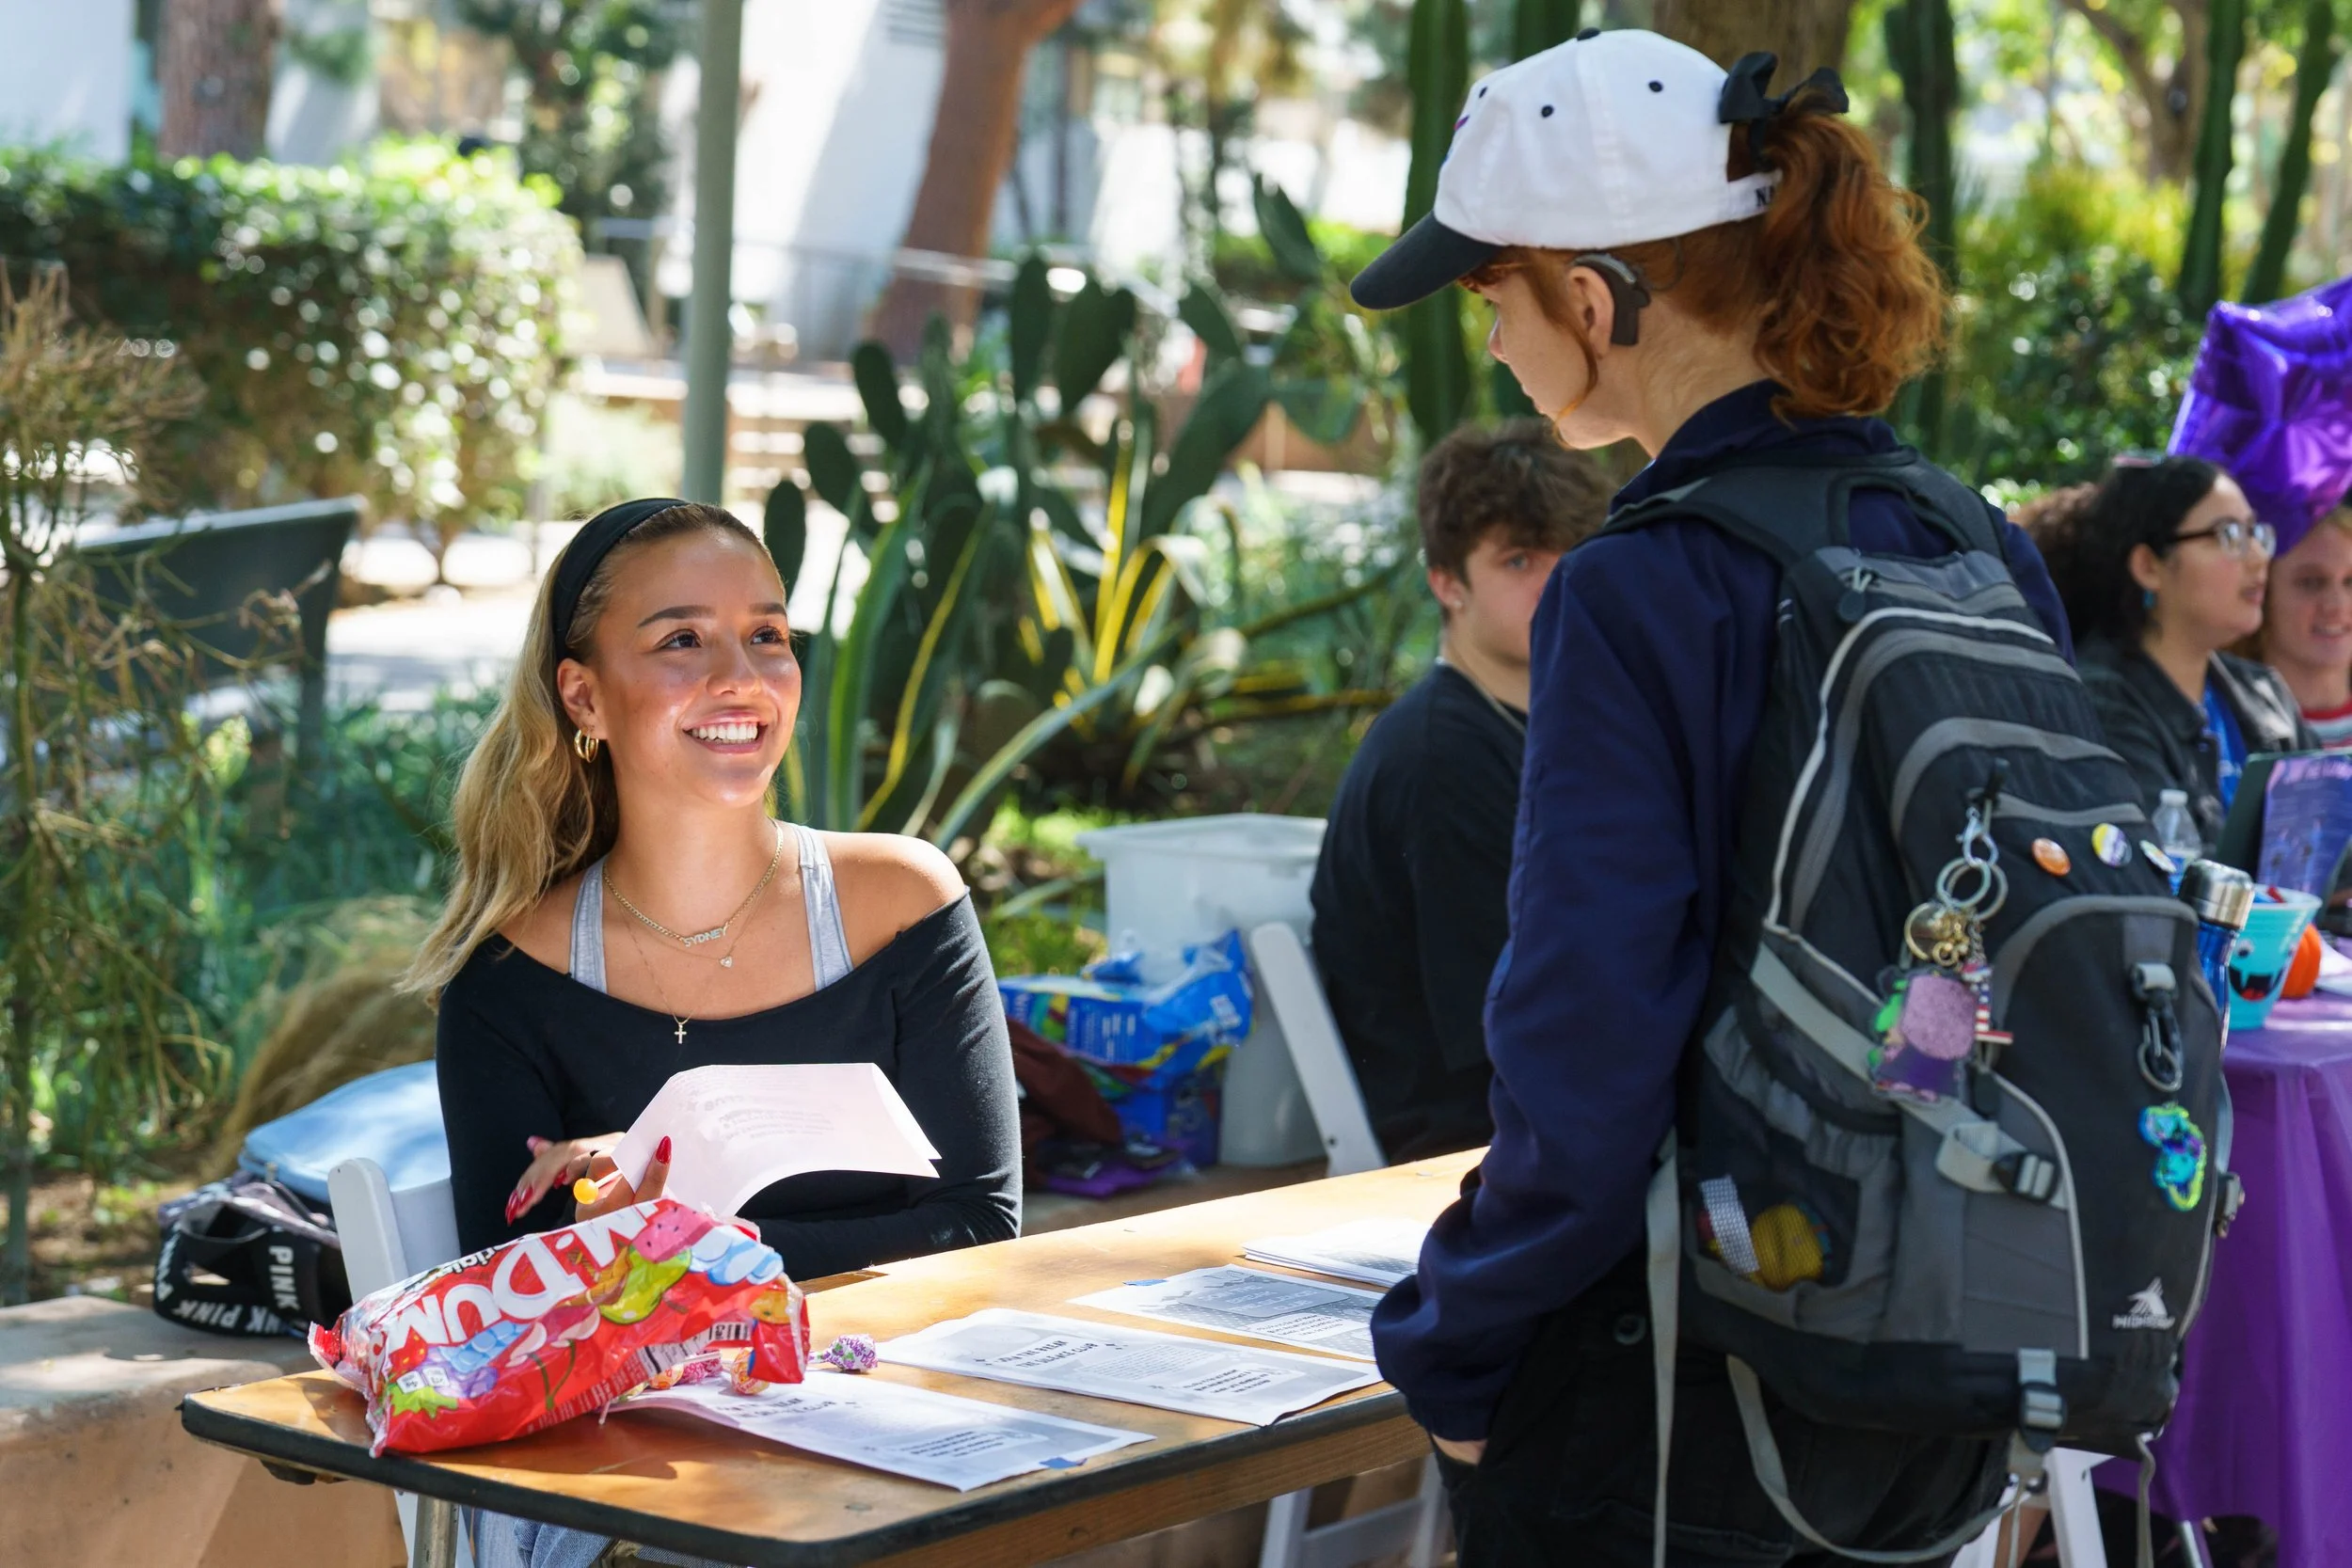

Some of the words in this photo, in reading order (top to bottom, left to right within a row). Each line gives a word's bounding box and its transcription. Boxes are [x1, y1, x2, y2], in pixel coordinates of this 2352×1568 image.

[684, 922, 729, 947] SYDNEY
[268, 1245, 300, 1311] PINK
[172, 1298, 243, 1328] PINK
